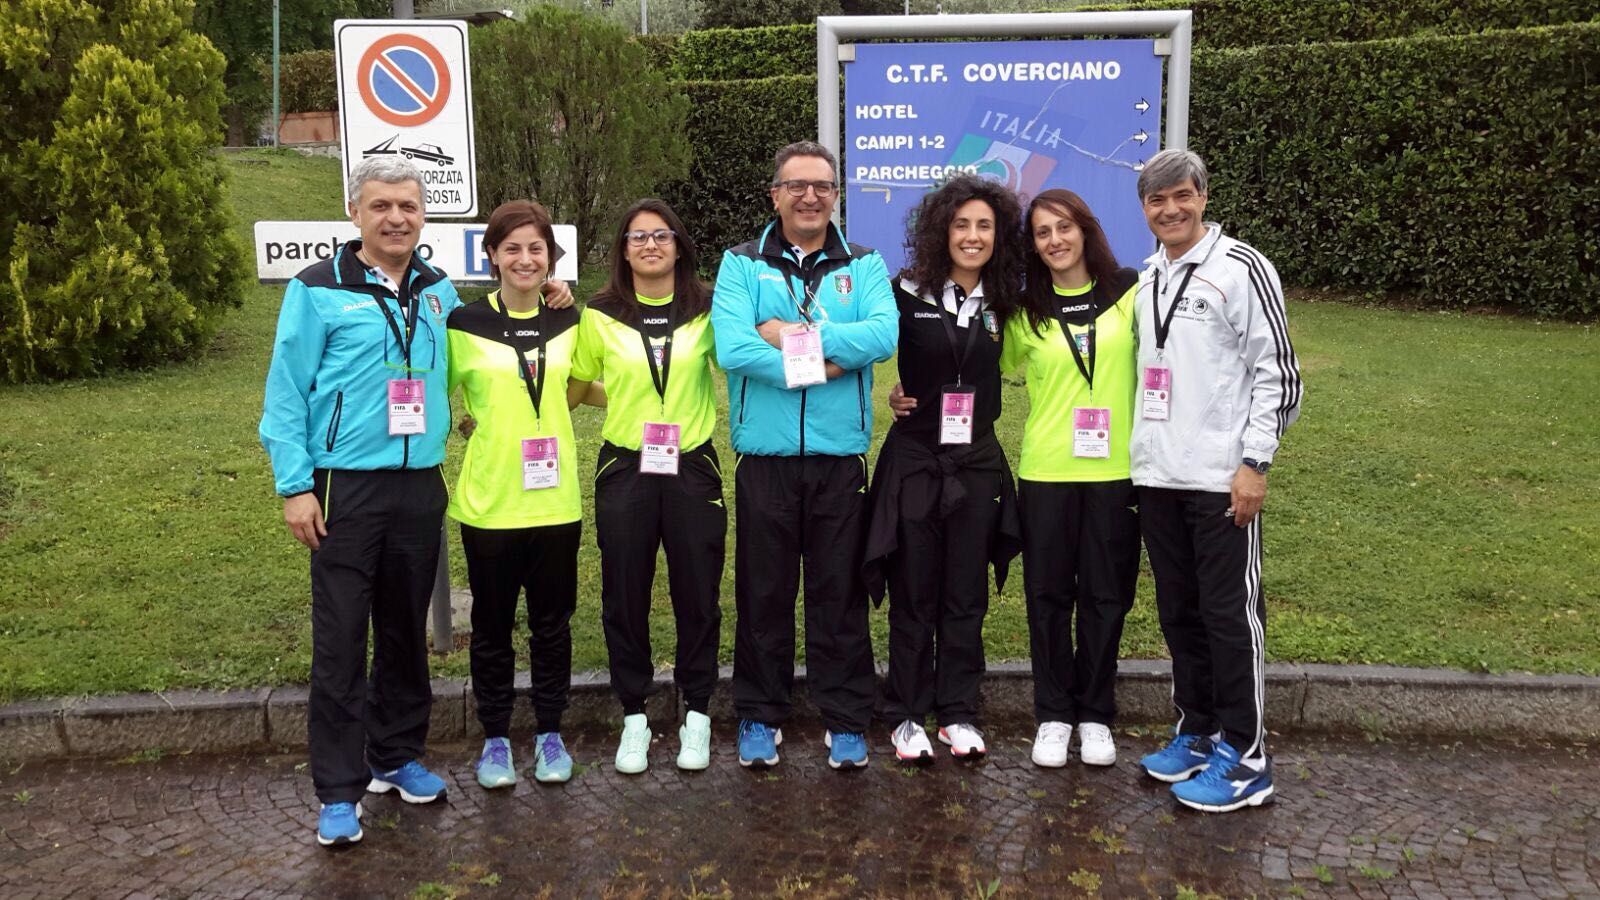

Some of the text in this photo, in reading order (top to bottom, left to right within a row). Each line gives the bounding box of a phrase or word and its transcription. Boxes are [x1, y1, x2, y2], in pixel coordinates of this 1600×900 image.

[886, 61, 1121, 83] C.T.F. COVERCIANO
[855, 104, 918, 119] HOTEL
[980, 110, 1062, 149] ITALIA
[855, 135, 945, 150] CAMPI 1-2
[420, 170, 464, 184] ORZATA
[426, 189, 462, 204] SOSTA
[265, 237, 434, 265] parcho
